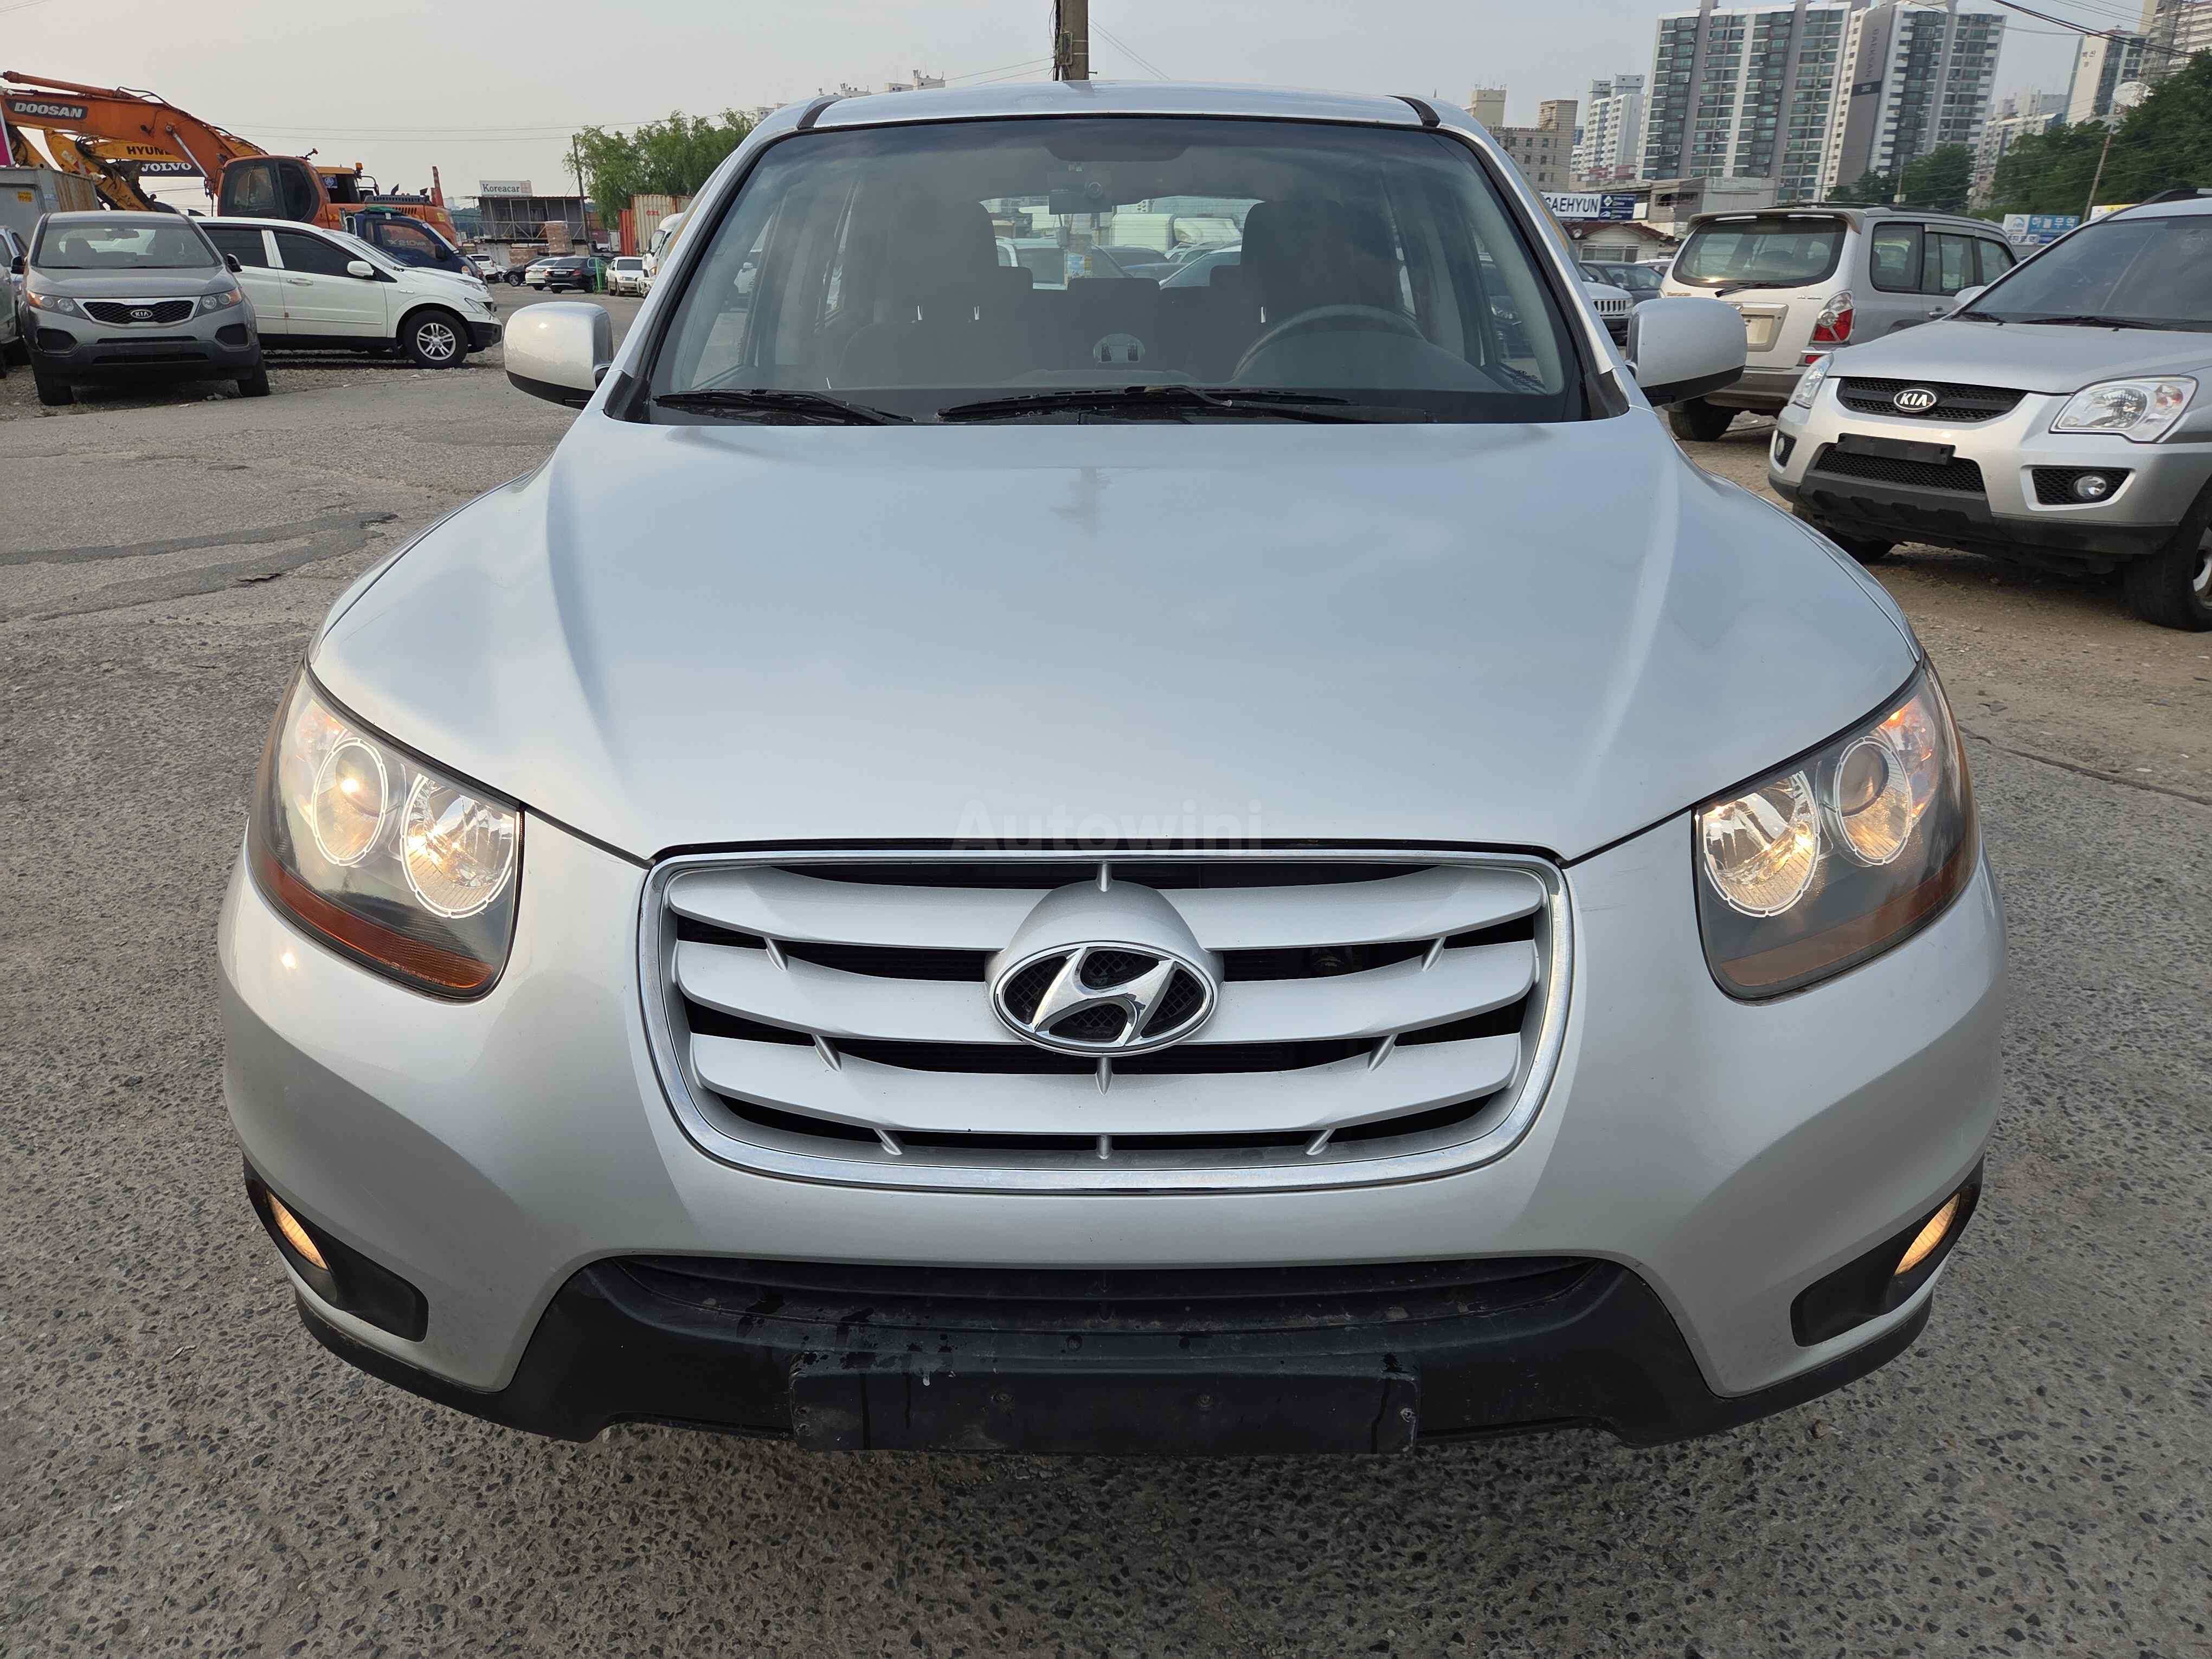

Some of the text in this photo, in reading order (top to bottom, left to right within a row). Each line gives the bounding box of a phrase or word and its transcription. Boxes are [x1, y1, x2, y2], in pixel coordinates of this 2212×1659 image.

[14, 102, 82, 118] DOOSAN
[482, 183, 520, 192] Koreacar
[1899, 393, 1927, 406] KIA
